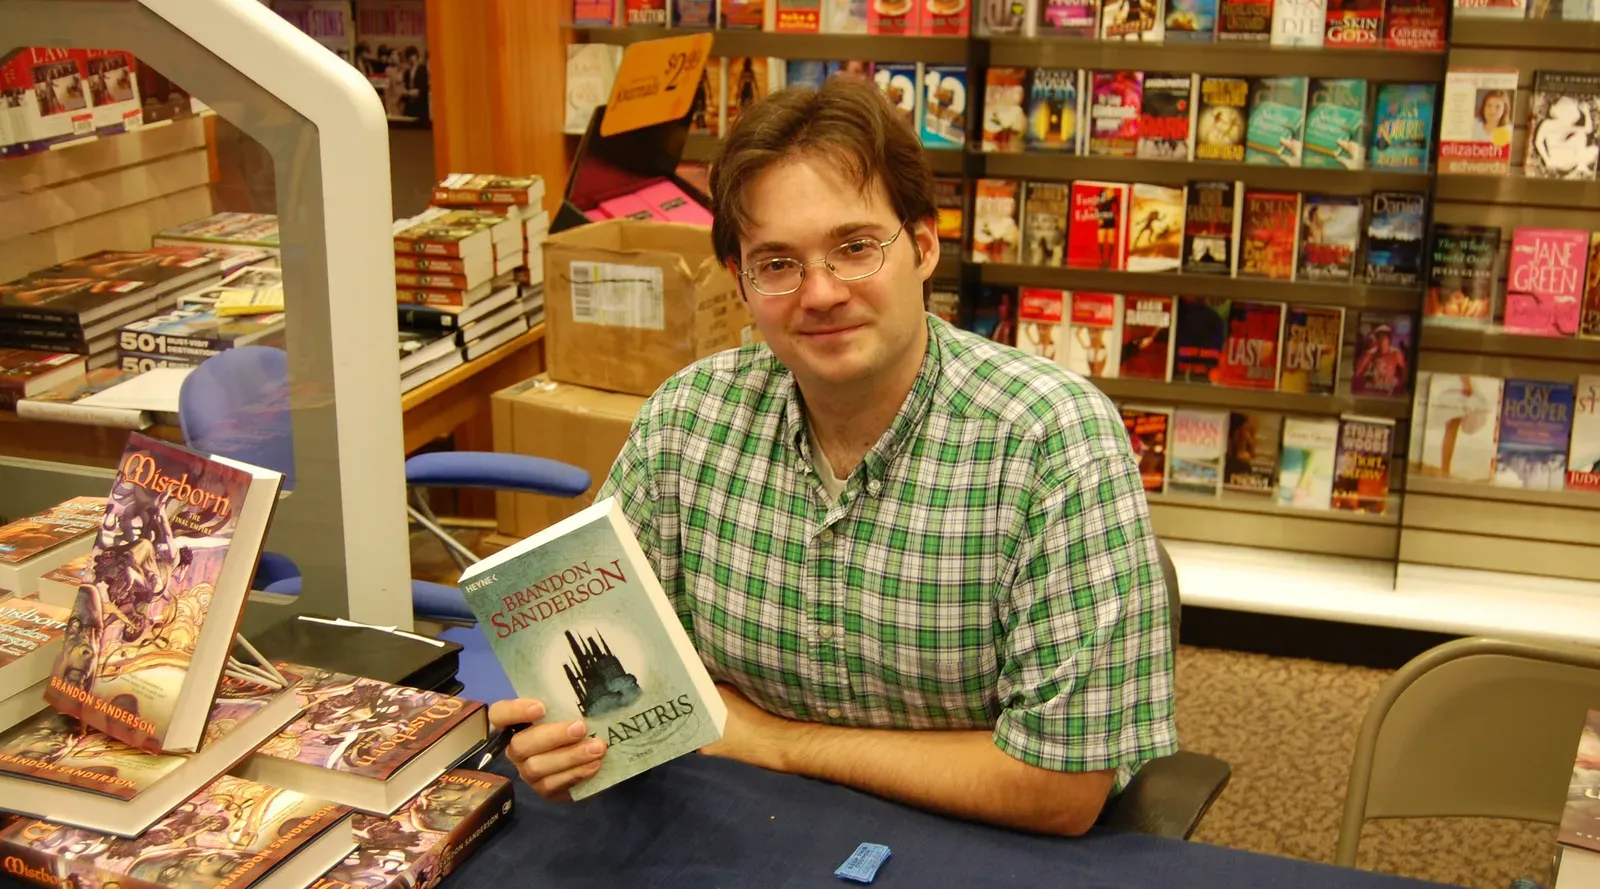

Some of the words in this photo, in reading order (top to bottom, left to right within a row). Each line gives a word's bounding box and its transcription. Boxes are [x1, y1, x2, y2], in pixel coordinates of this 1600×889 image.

[1282, 18, 1321, 34] DIE
[1327, 27, 1377, 43] GODS
[1343, 17, 1378, 30] SKIN
[1441, 144, 1503, 158] elizabeth
[1450, 160, 1507, 173] edwards
[1372, 192, 1424, 217] Daniel
[1528, 238, 1576, 267] JANE
[1513, 264, 1578, 294] GREEN
[120, 331, 166, 354] 501
[1228, 337, 1265, 366] LAST
[1524, 384, 1550, 402] KAY
[1504, 398, 1568, 422] HOOPER
[1343, 423, 1391, 439] STUART
[1343, 437, 1389, 453] WOODS
[123, 453, 230, 517] Mistborn
[171, 515, 190, 527] FINAL
[189, 521, 213, 536] EMPIRE
[189, 512, 202, 521] THE
[465, 577, 494, 593] HEYNE
[502, 560, 593, 613] BRANDON
[490, 558, 628, 639] SANDERSON
[50, 676, 95, 706] BRANDON
[94, 698, 156, 736] SANDERSON
[356, 696, 463, 768] Mistborn
[588, 693, 694, 748] ANTRIS
[57, 765, 137, 788] SANDERSON
[438, 774, 493, 790] BRANDO
[464, 812, 499, 847] SANDERSON
[213, 848, 273, 889] BRANDON
[270, 804, 337, 850] SANDERSON
